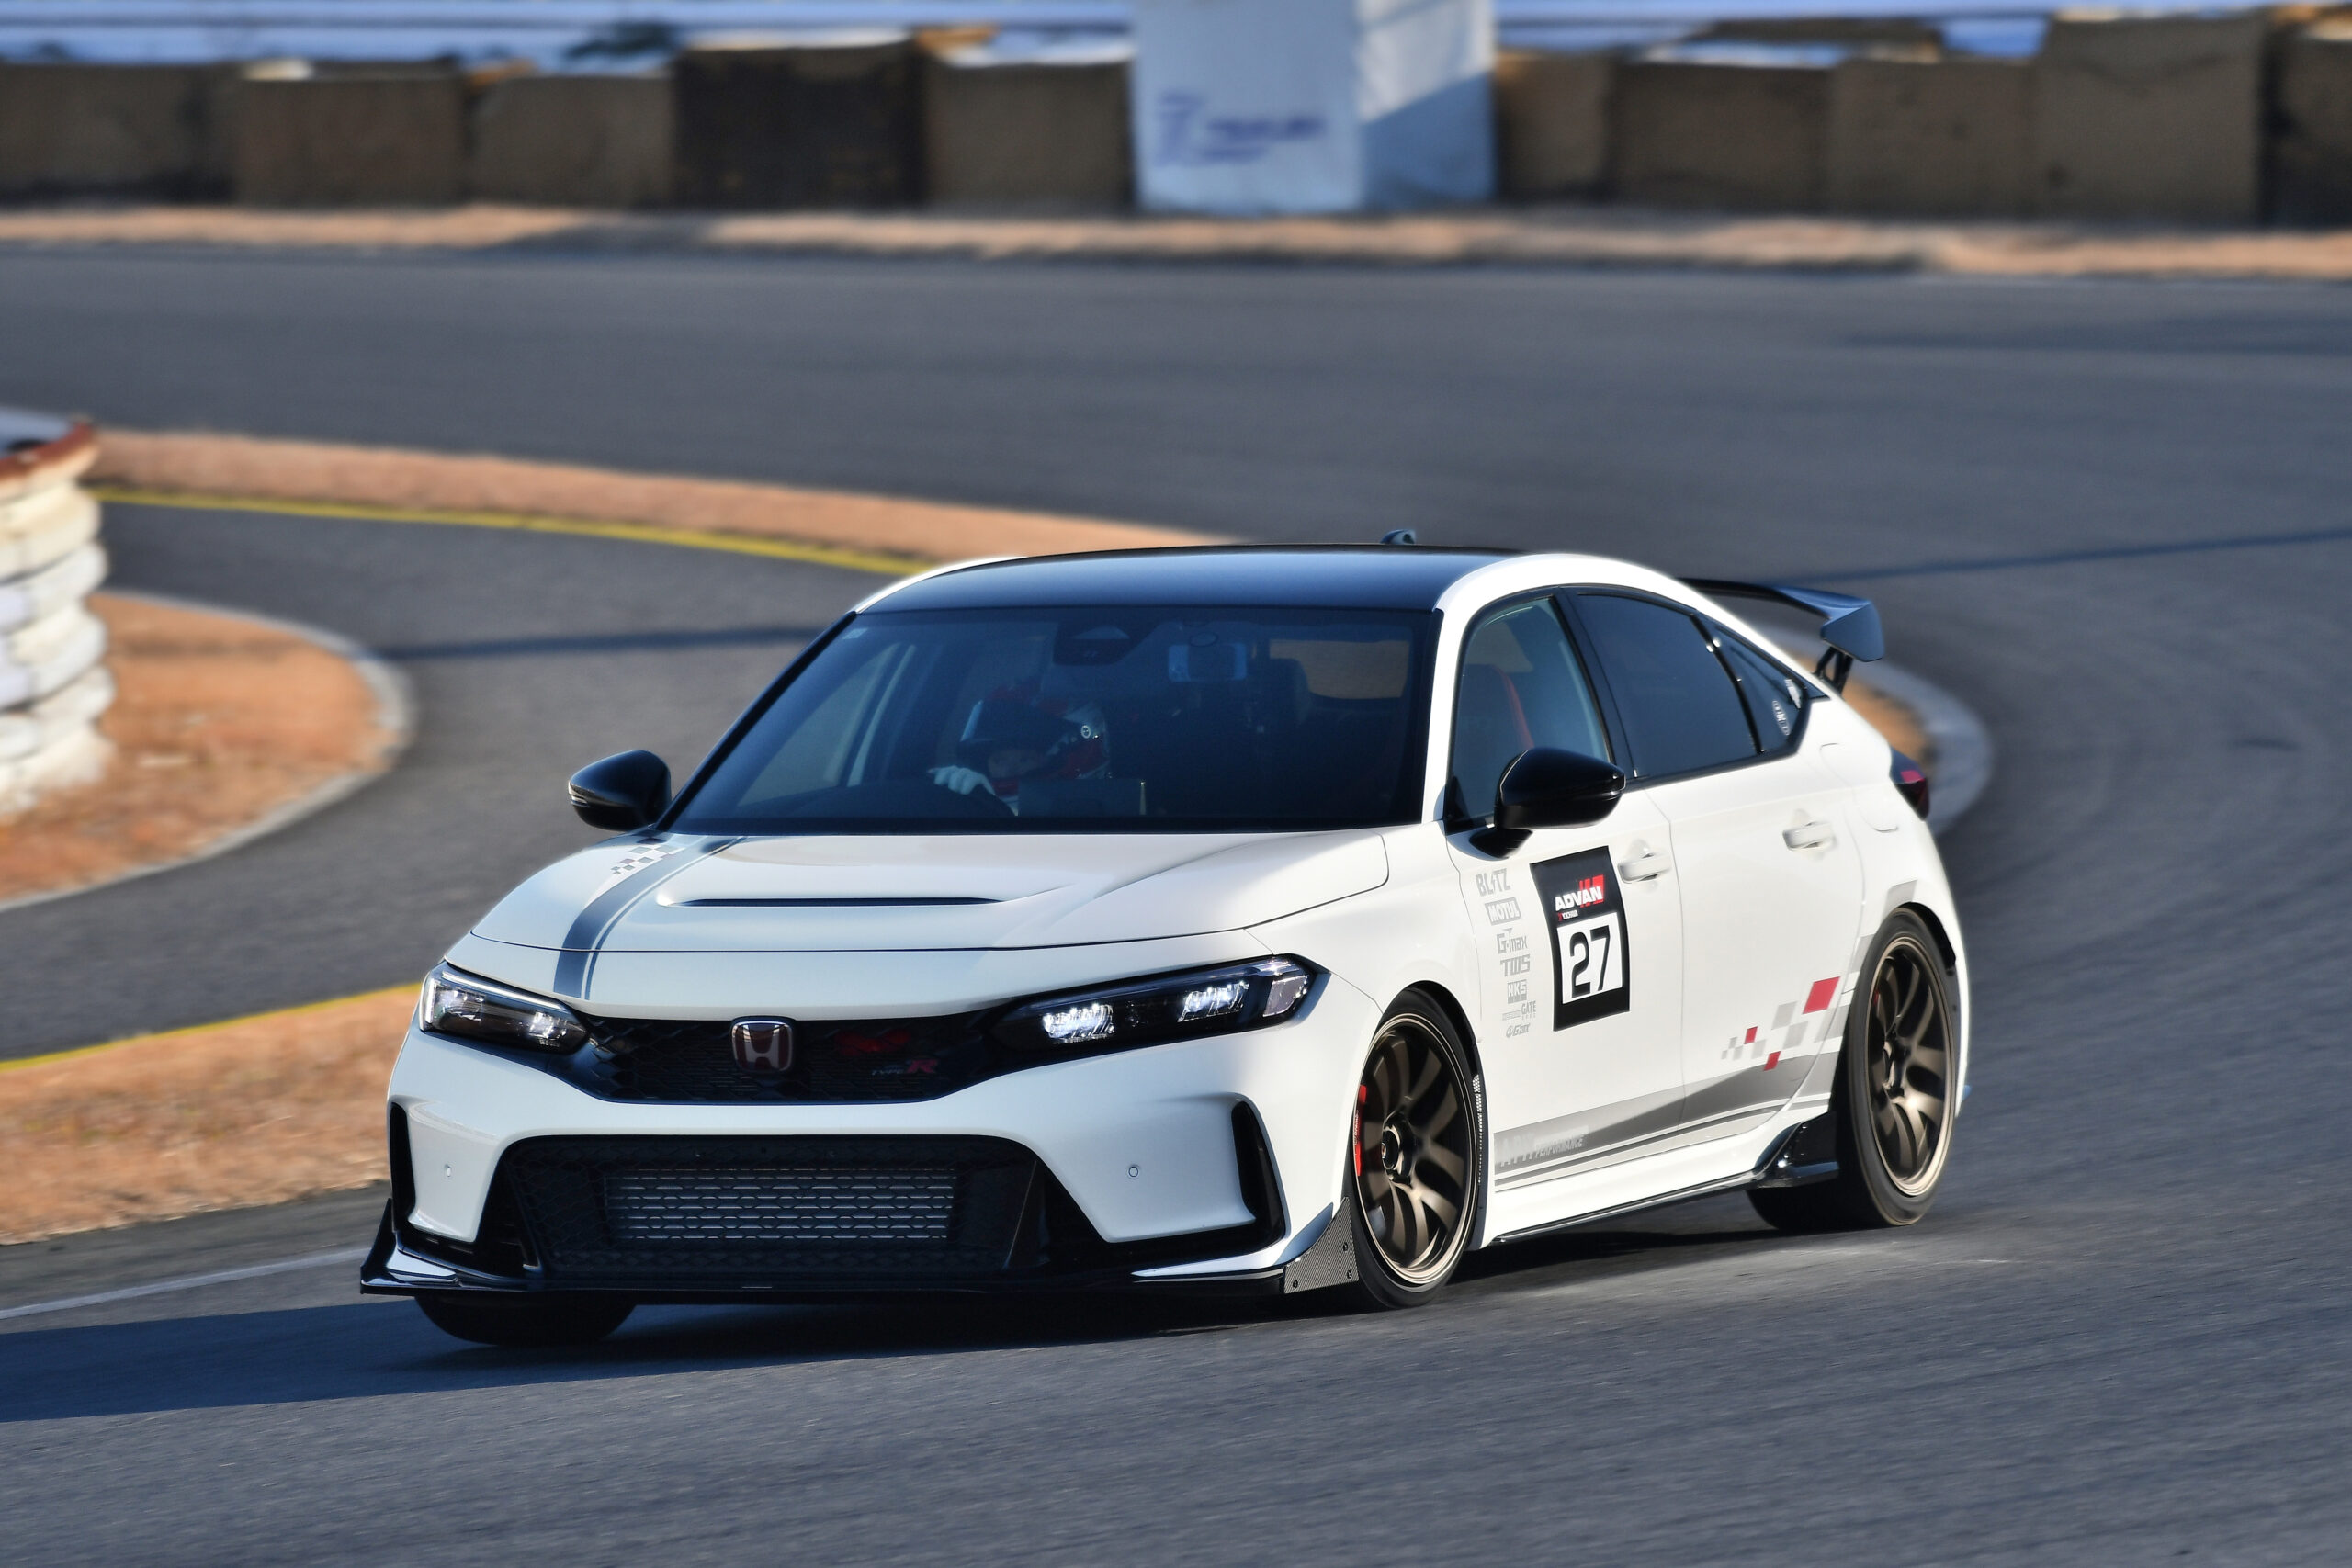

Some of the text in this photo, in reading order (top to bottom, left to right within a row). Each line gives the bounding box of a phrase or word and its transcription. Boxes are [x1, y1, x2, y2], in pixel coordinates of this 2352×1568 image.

[1476, 868, 1511, 897] BLITZ
[1555, 886, 1604, 911] ADVAN
[1487, 900, 1521, 923] MOTUL
[1499, 953, 1531, 977] TWS
[1569, 924, 1611, 998] 27
[1508, 980, 1527, 999] HKS
